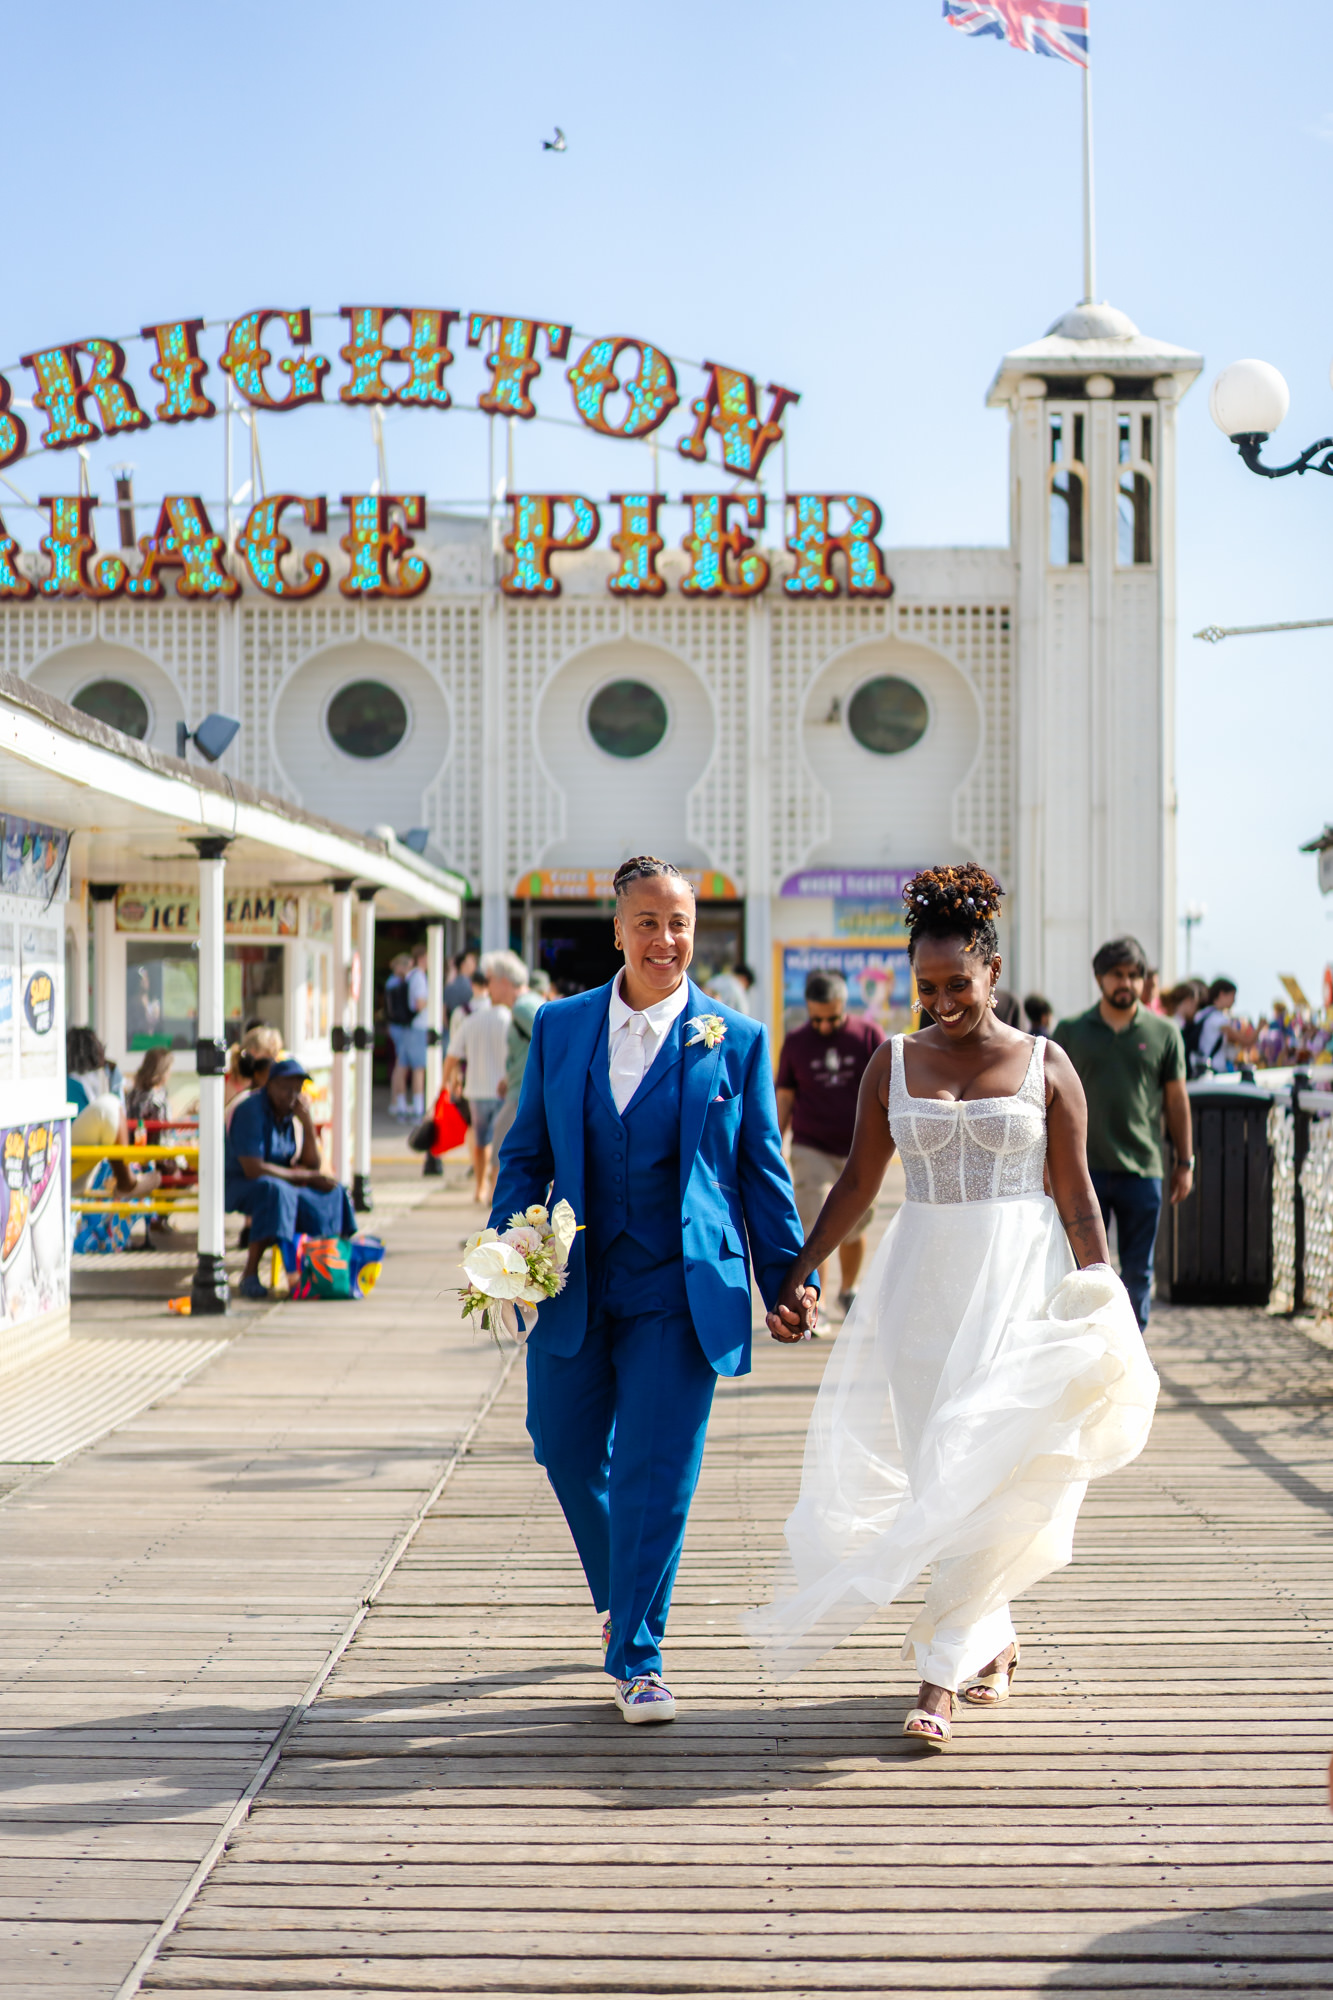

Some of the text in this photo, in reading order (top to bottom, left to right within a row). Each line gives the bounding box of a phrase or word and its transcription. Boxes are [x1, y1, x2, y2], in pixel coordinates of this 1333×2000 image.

[0, 494, 895, 599] LACE PIER
[152, 901, 192, 931] ICE
